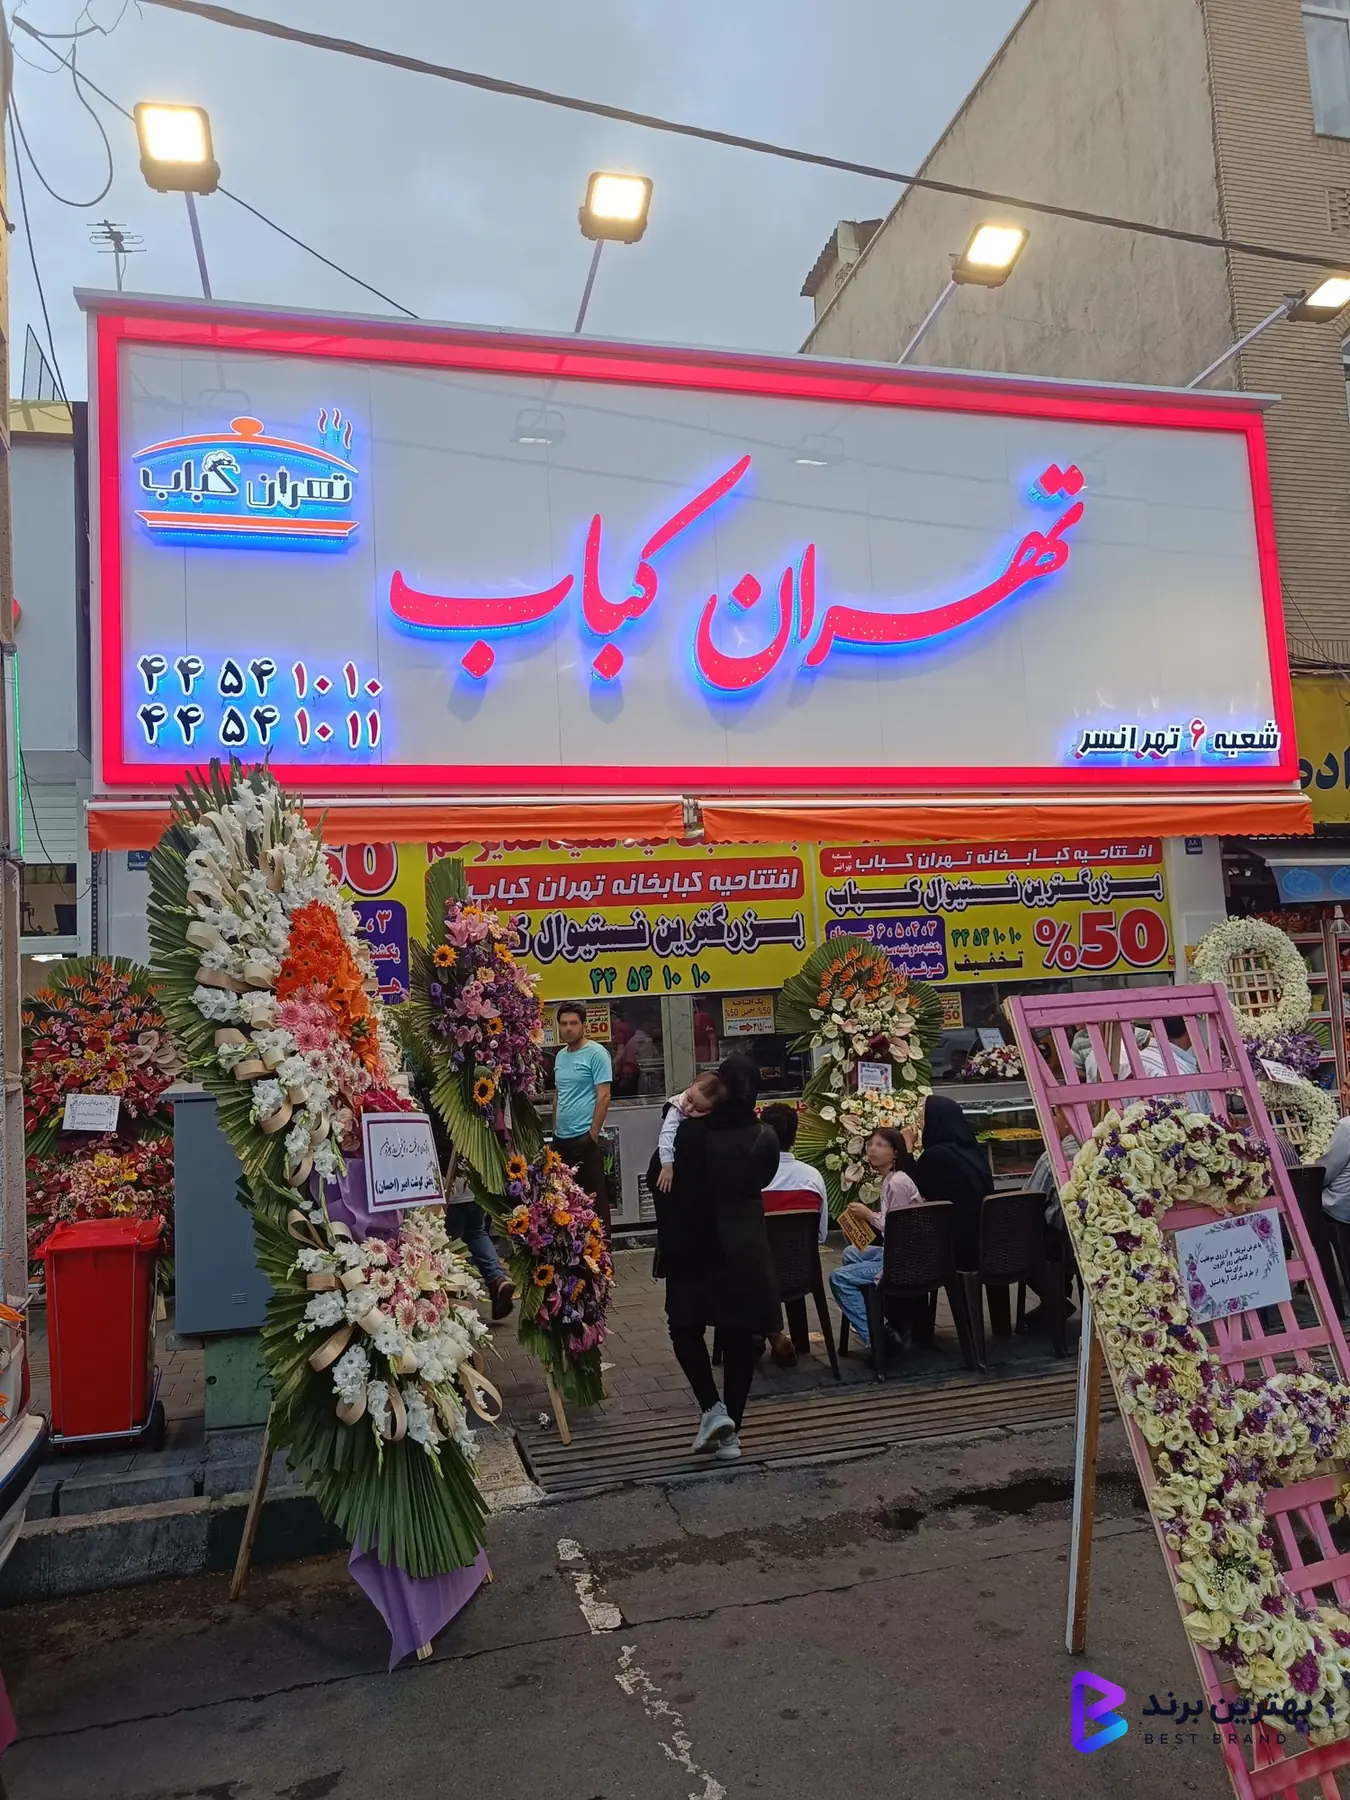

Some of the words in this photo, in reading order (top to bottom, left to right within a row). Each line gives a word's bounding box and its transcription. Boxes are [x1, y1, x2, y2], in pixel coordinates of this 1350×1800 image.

[140, 453, 241, 503] کباب
[388, 455, 752, 683] کباب
[695, 464, 1086, 691] تهران
[1213, 720, 1281, 758] شعبه
[855, 852, 914, 872] کباب
[917, 850, 973, 869] تهران
[977, 847, 1070, 867] کبابخانه
[1073, 844, 1153, 864] افتتاحیه
[537, 875, 606, 902] تهران
[611, 870, 703, 899] کبابخانه
[708, 868, 799, 892] افتتاحیه
[825, 875, 922, 917] کباب
[923, 871, 1022, 913] فستیوال
[1022, 866, 1165, 908] بزرگترین
[533, 908, 652, 964] فستیوال
[652, 902, 807, 957] بزرگترین
[1033, 907, 1169, 973] %50
[953, 950, 1025, 974] تخفیف
